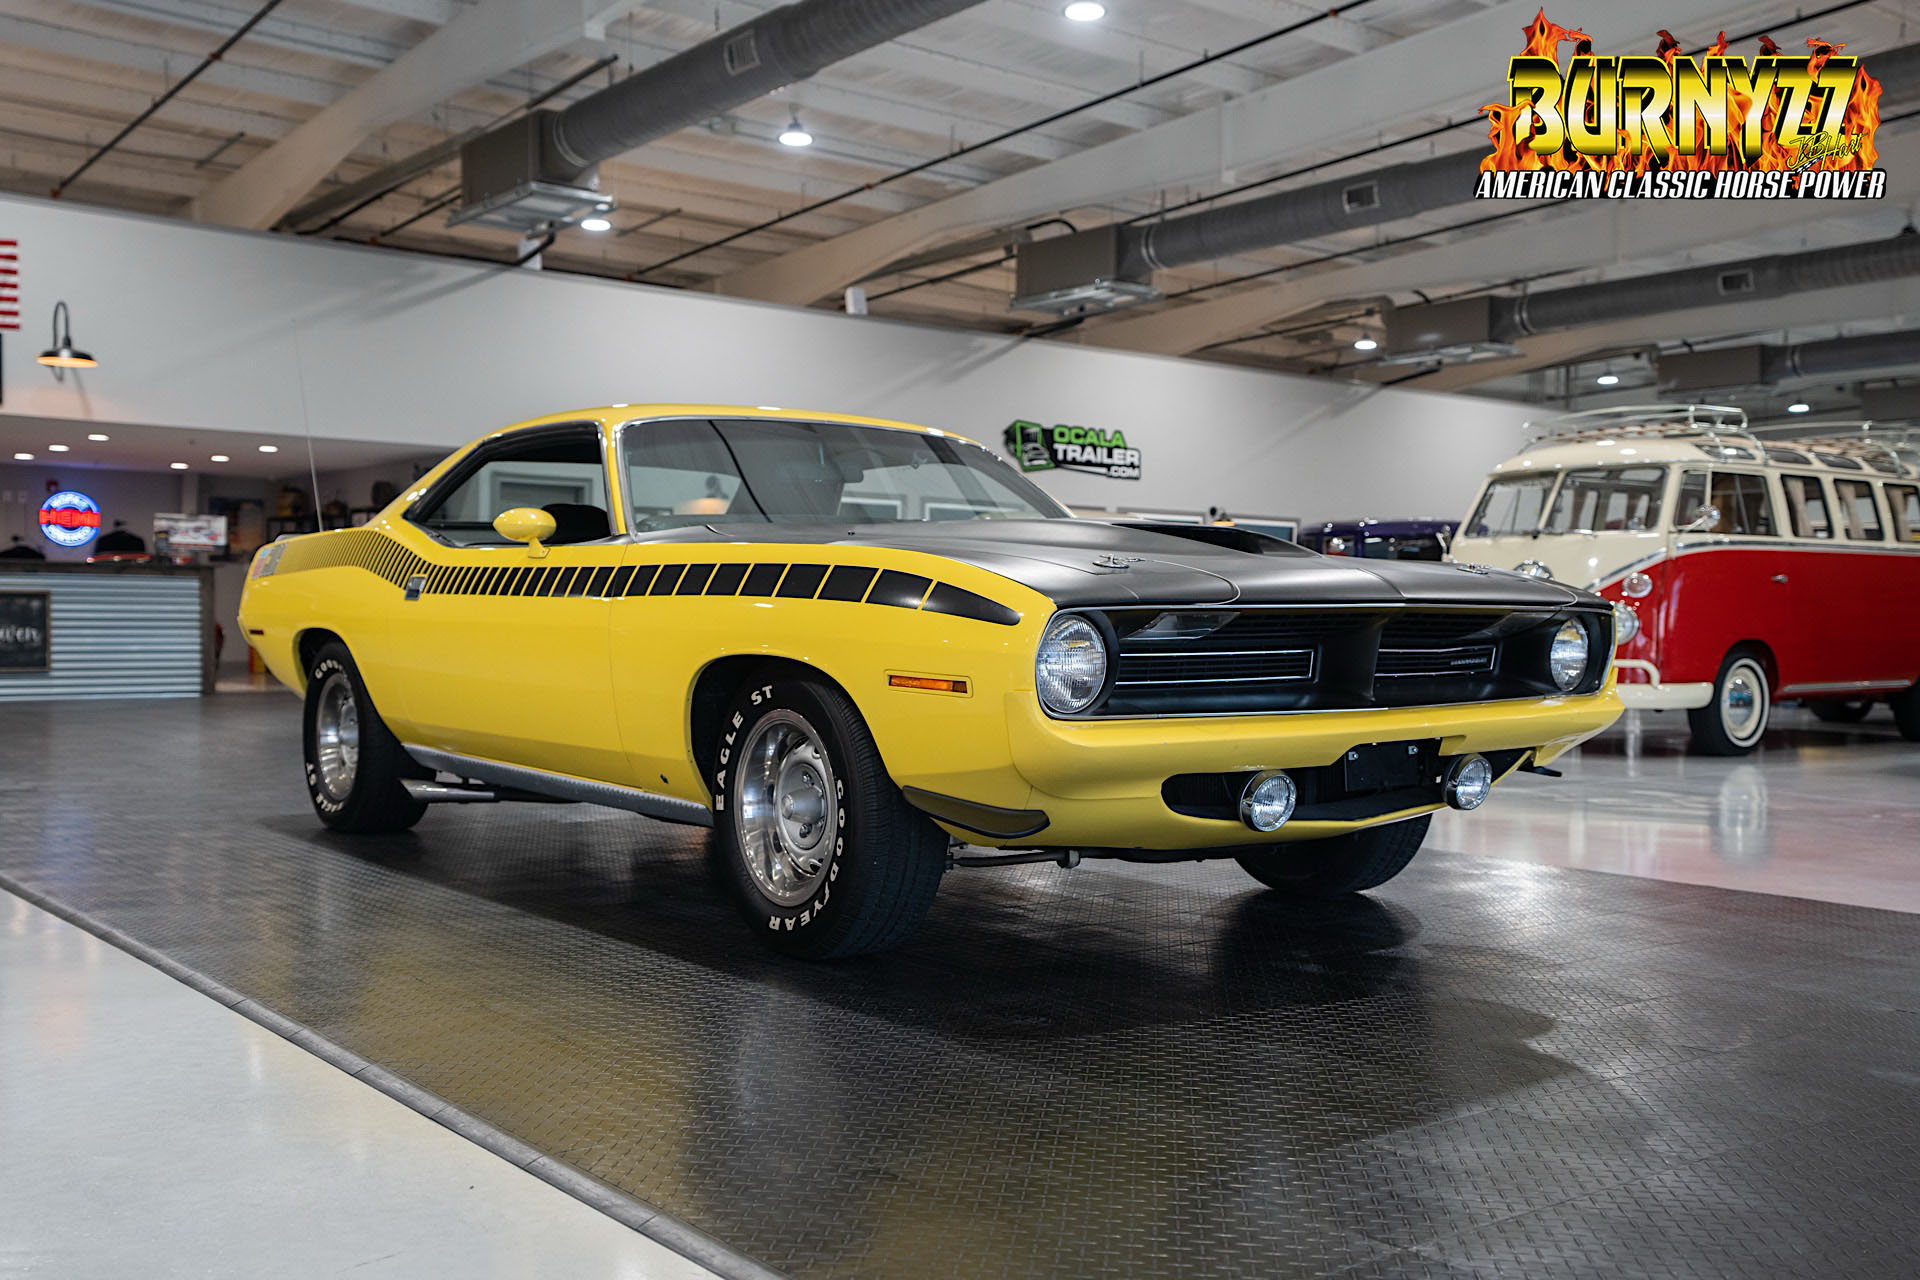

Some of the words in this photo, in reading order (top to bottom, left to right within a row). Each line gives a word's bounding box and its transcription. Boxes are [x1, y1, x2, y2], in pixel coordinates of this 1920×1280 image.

[1053, 425, 1125, 447] OCALA
[1053, 443, 1140, 466] TRAILER
[715, 711, 744, 811] EAGLE
[751, 684, 773, 705] ST
[768, 779, 846, 931] GOODYEAR
